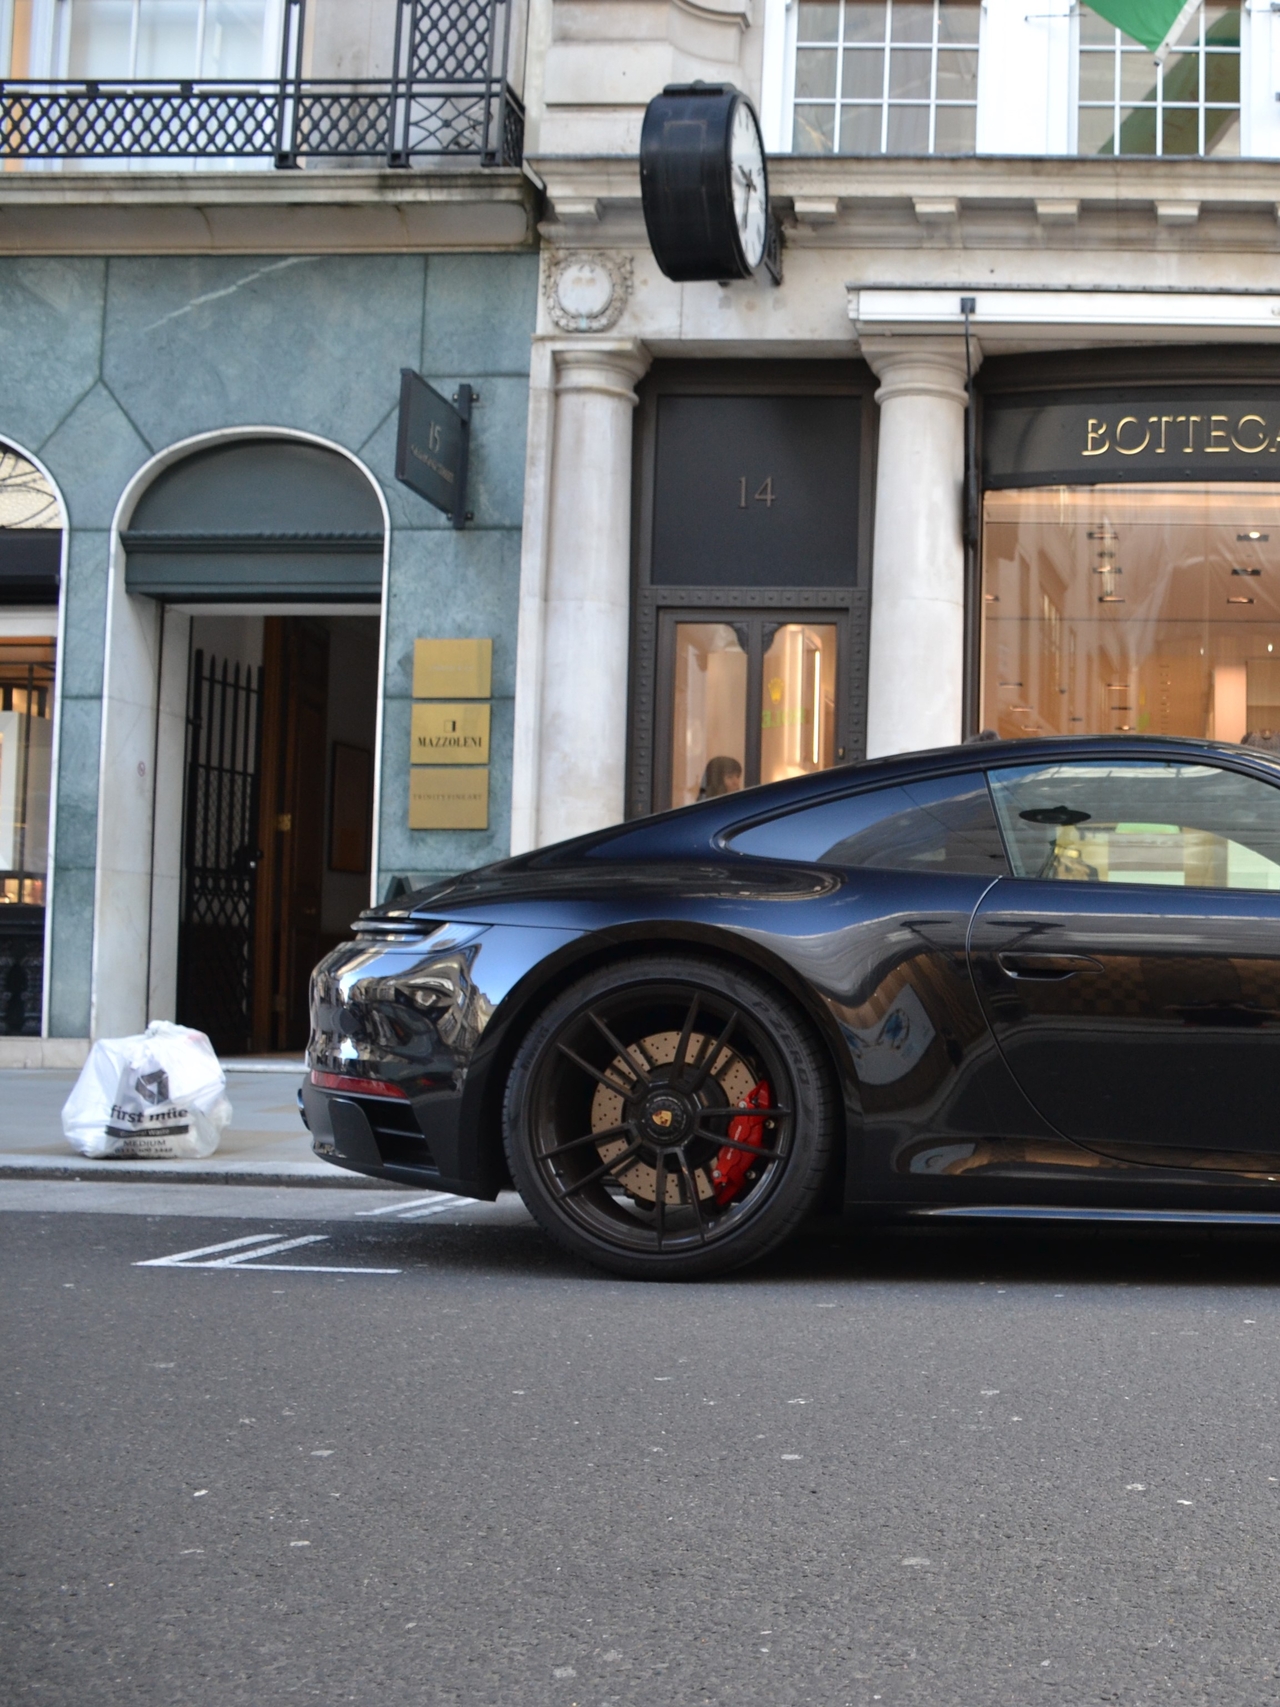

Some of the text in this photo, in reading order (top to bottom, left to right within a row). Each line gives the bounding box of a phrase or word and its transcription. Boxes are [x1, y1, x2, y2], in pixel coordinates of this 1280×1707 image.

[428, 421, 442, 453] 15
[738, 476, 776, 508] 14
[418, 736, 482, 748] MAZZOLENI
[111, 1104, 145, 1123] first
[123, 1139, 166, 1147] MEDIUM
